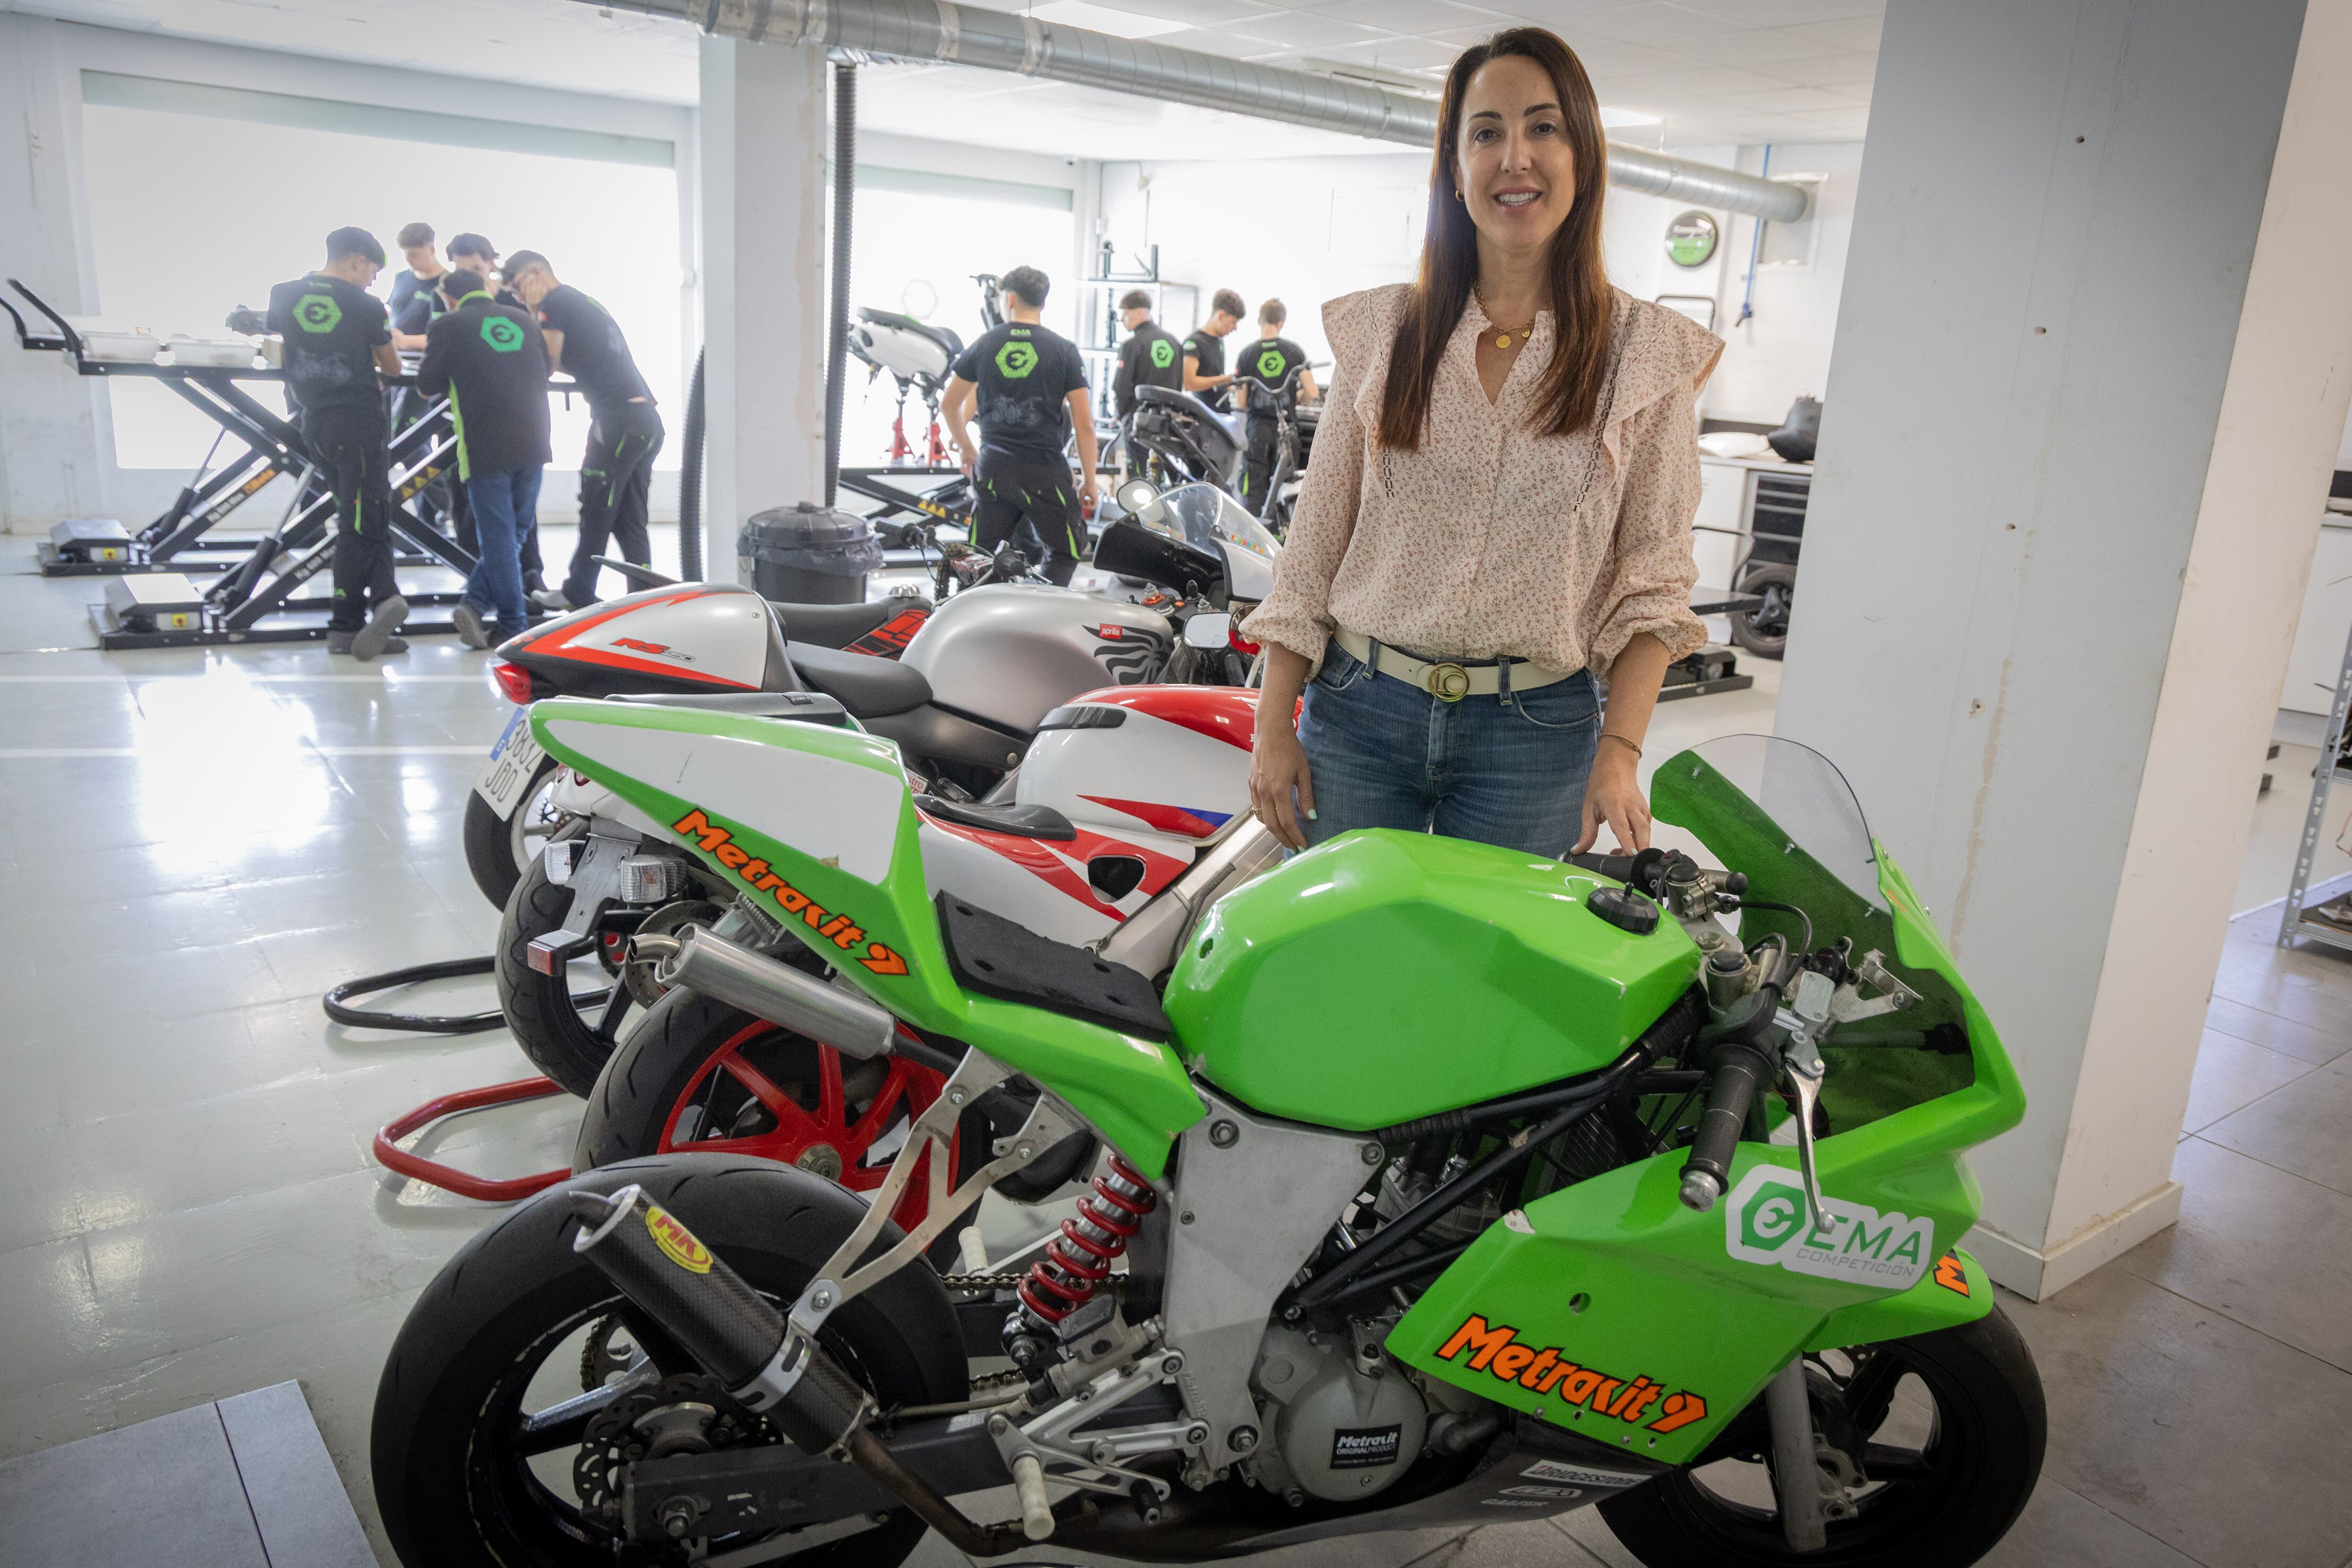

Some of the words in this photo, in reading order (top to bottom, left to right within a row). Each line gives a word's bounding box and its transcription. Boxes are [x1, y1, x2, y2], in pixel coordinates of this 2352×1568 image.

[671, 808, 866, 950] Metrakit
[854, 941, 910, 976] 9
[1796, 1248, 1914, 1276] COMPETICIÓN
[1434, 1312, 1666, 1423] Metrakit
[1641, 1389, 1708, 1435] 9
[1336, 1446, 1368, 1455] ORIGINAL
[1368, 1443, 1396, 1453] PRODUCT
[1337, 1432, 1398, 1448] Metrakit
